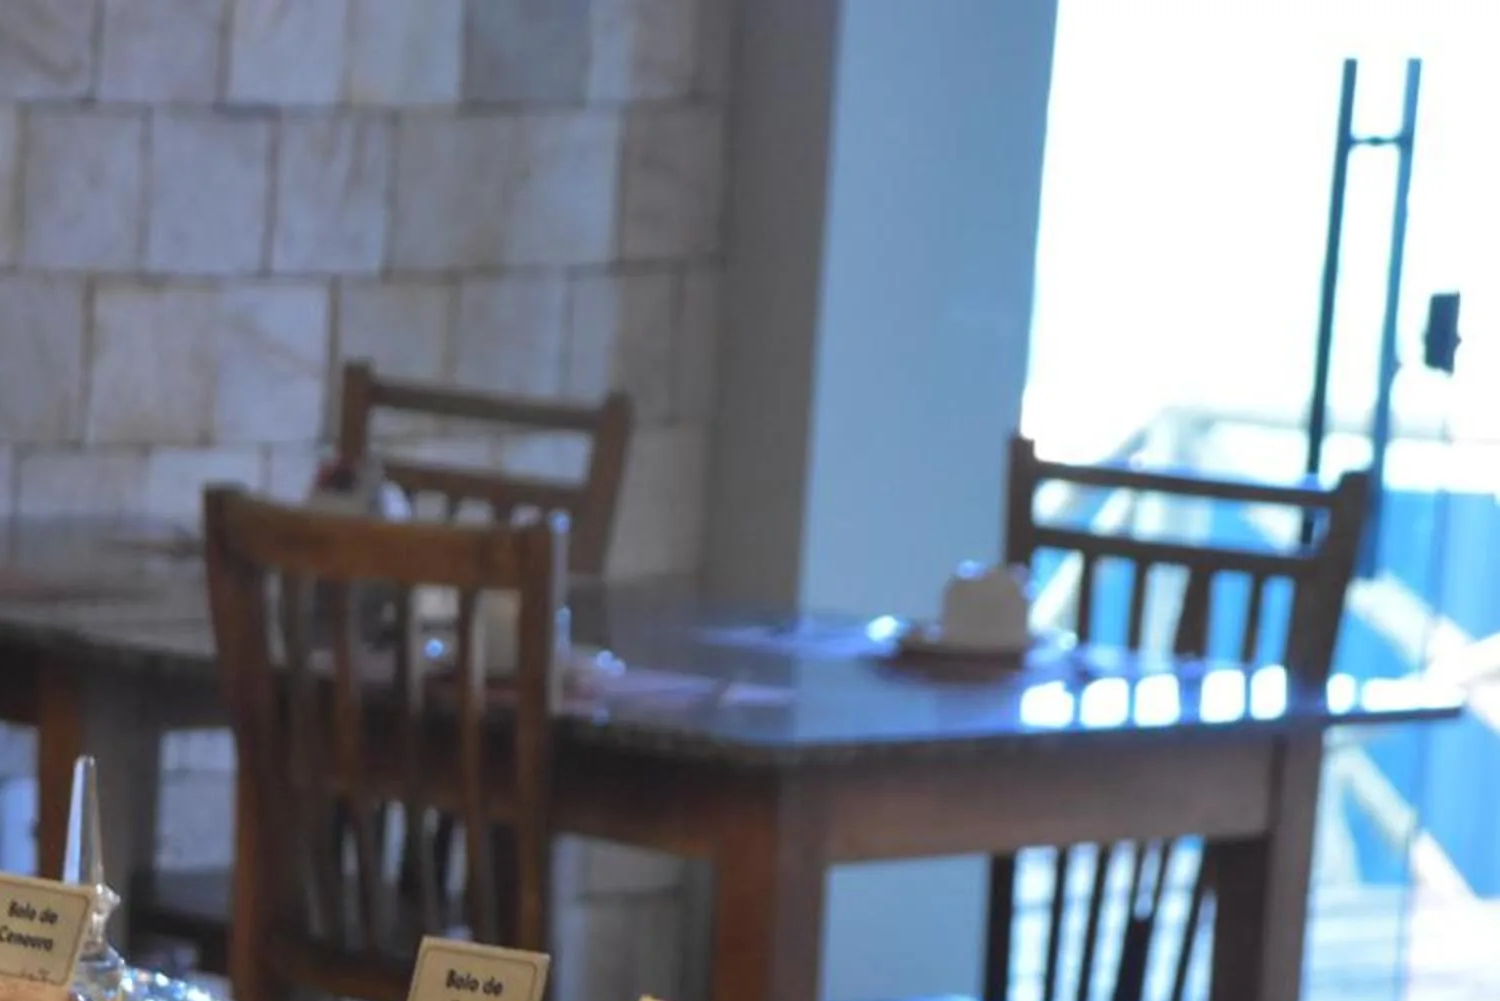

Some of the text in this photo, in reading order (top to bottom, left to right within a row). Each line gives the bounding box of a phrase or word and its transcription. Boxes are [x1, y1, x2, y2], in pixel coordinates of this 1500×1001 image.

[8, 900, 59, 926] Bolo de
[445, 968, 504, 998] Bolo de
